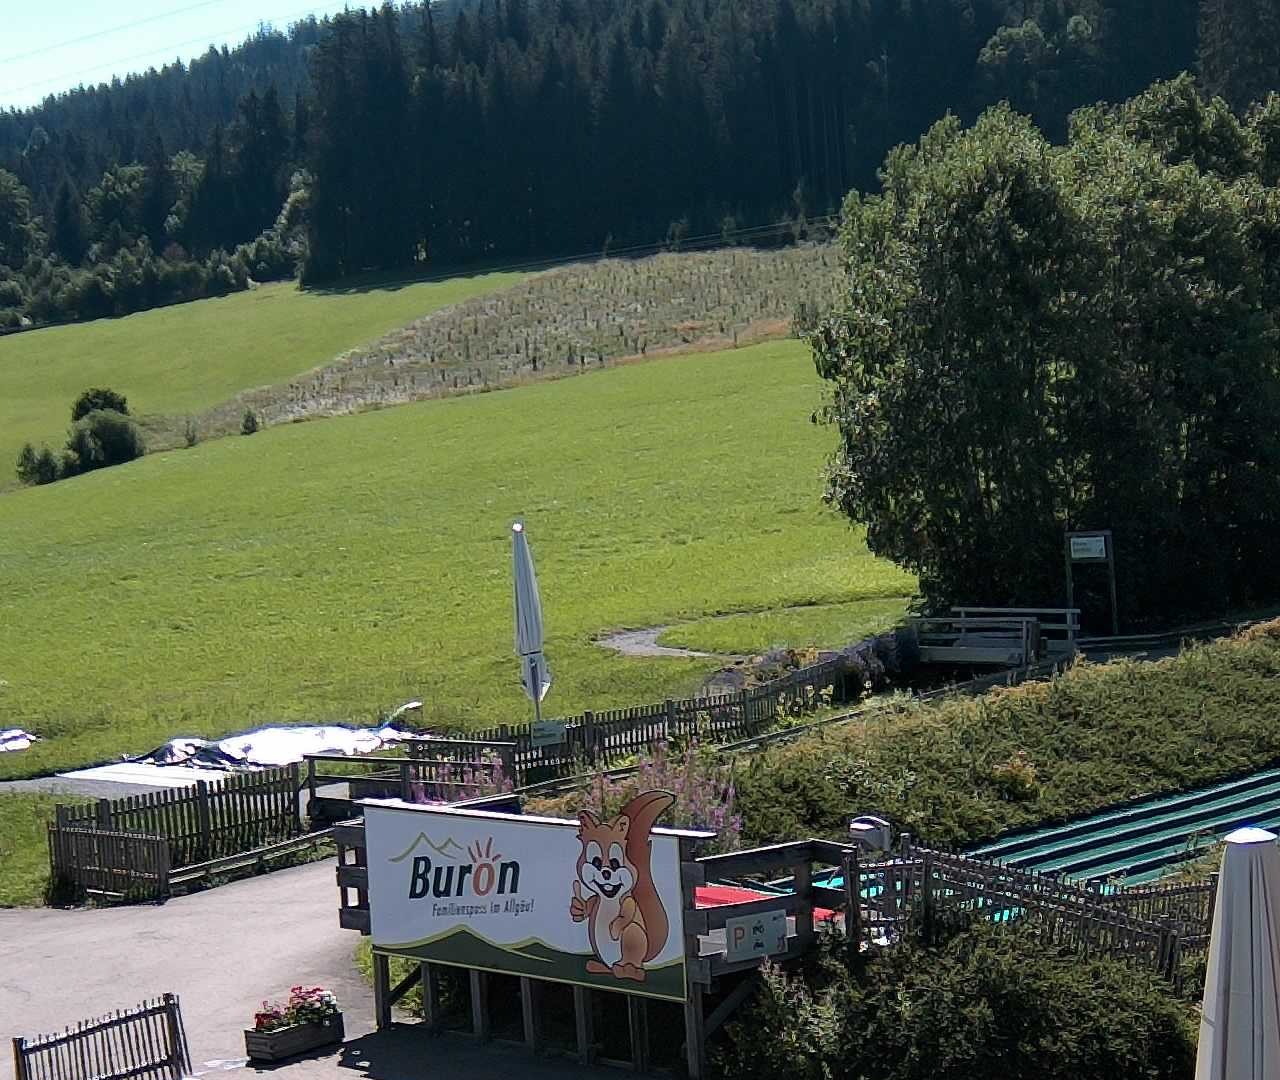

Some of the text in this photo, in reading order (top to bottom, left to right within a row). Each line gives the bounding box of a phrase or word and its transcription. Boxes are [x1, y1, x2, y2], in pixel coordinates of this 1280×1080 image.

[408, 852, 521, 899] Buron
[490, 900, 501, 913] im
[734, 926, 745, 949] P
